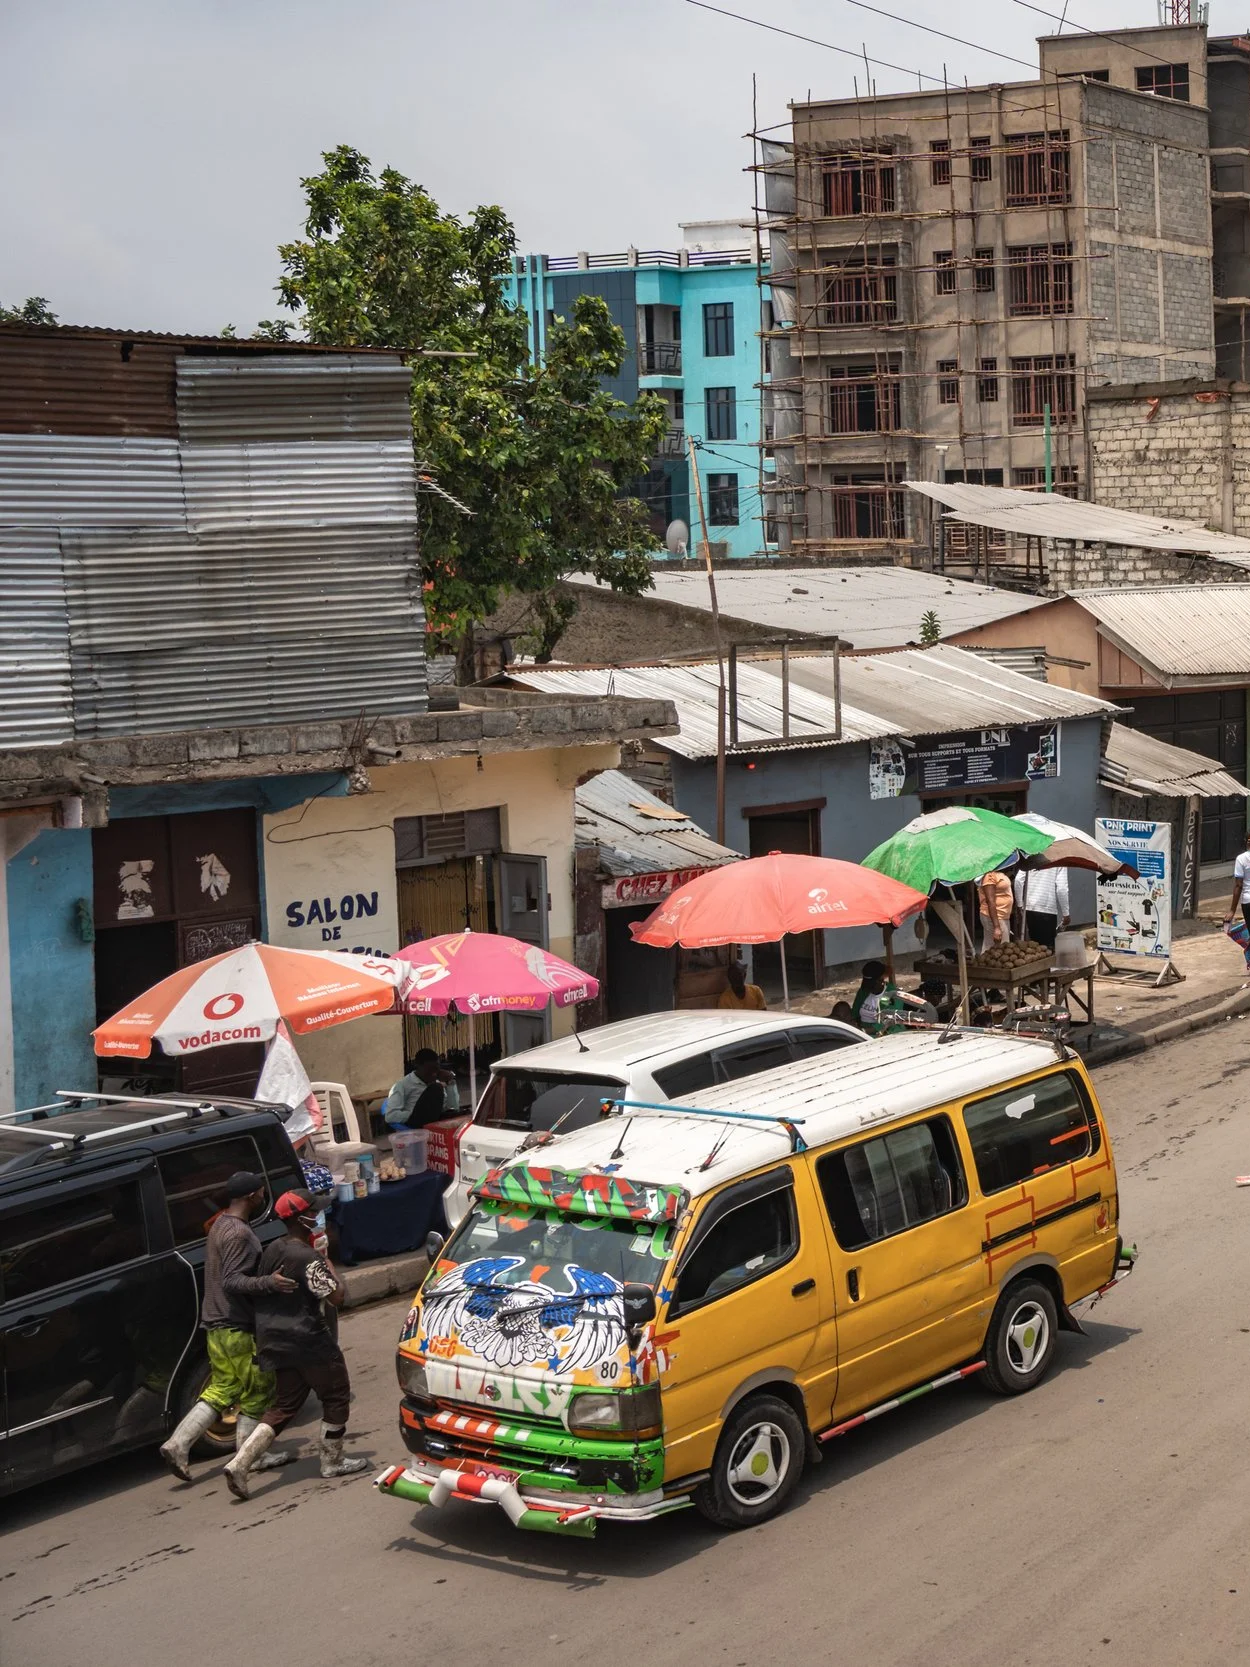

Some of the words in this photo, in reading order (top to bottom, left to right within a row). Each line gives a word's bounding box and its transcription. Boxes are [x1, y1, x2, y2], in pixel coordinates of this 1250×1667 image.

[981, 730, 1010, 746] PNK
[1106, 820, 1125, 831] PNK
[1127, 822, 1154, 832] PRINT
[616, 874, 668, 901] CHEZ
[286, 891, 379, 927] SALON
[807, 900, 848, 914] airtel
[322, 926, 342, 941] DE
[482, 995, 536, 1007] afrimoney
[306, 999, 379, 1025] Qualité-Couverture
[178, 1026, 261, 1050] vodacom
[600, 1361, 618, 1380] 80
